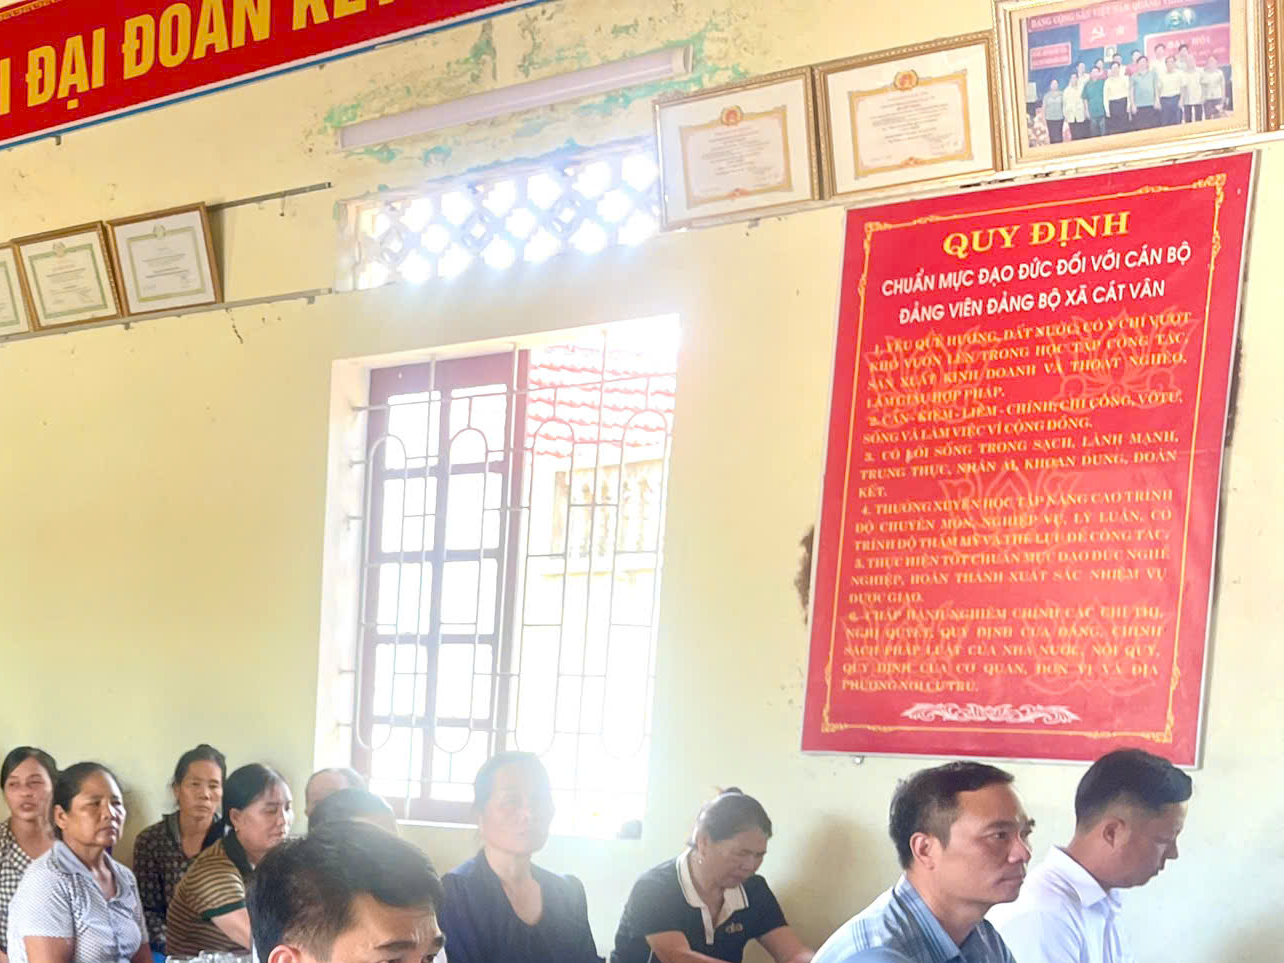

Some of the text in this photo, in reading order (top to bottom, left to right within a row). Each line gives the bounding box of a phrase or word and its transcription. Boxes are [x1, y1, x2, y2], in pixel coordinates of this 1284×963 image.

[26, 27, 106, 110] ĐẠI
[943, 210, 1131, 259] QUY ĐỊNH
[881, 240, 1191, 296] CHUẨN MỰC ĐẠO ĐỨC ĐỐI VỚI CÁN BỘ
[899, 277, 1165, 324] ĐẢNG VIÊN ĐẢNG BỘ XÃ CÁT VÂN
[982, 346, 1029, 362] TRONG
[943, 369, 978, 384] KINH
[985, 363, 1036, 380] DOANH
[979, 439, 1027, 454] TRONG
[859, 466, 906, 481] TRUNG
[1024, 454, 1076, 470] KHOAN
[1090, 490, 1122, 505] CAO
